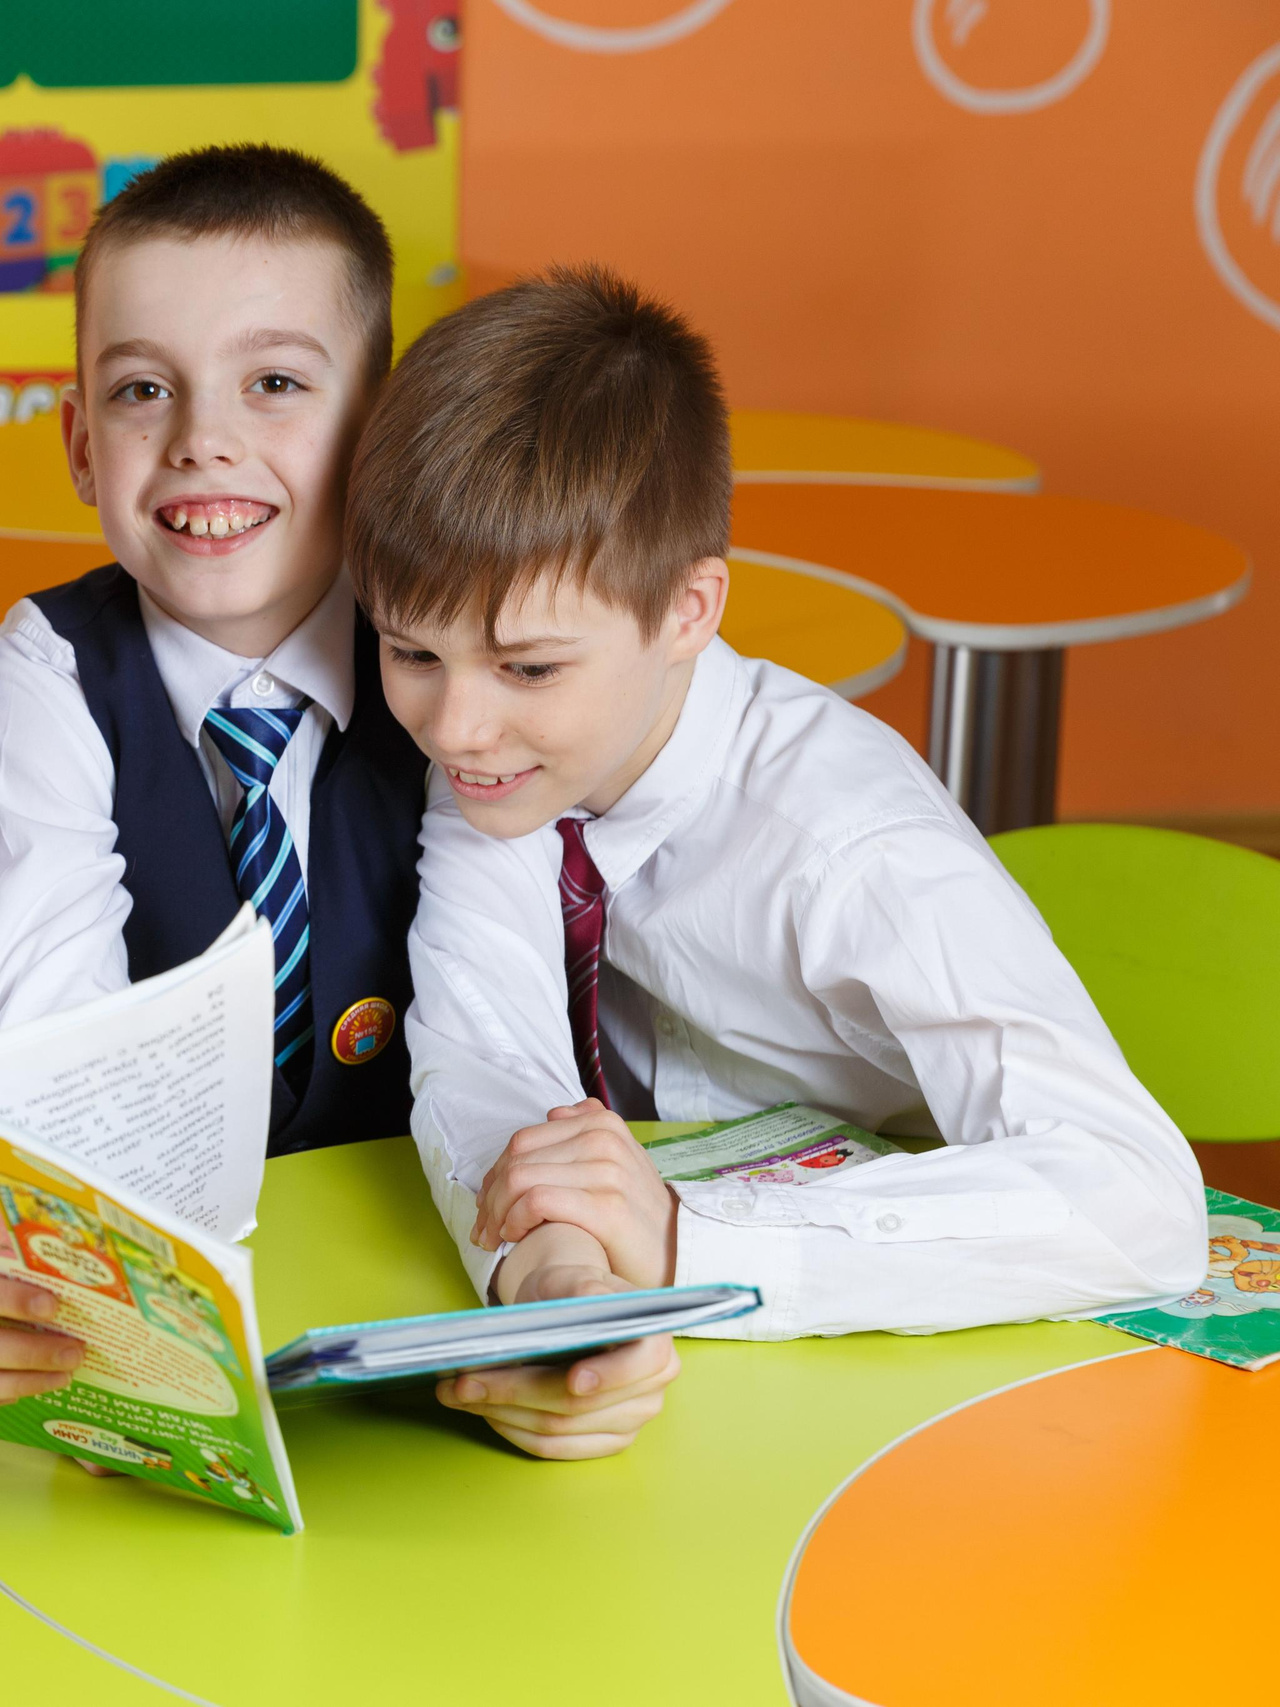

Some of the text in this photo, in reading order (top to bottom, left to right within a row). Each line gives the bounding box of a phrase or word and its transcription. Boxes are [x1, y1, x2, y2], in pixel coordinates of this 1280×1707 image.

[4, 190, 36, 246] 2
[60, 188, 89, 238] 3
[341, 1003, 369, 1031] СРЕДНЯЯ
[34, 1394, 62, 1408] БЕЗ
[77, 1387, 108, 1404] БЕЗ
[67, 1404, 113, 1423] САМИ
[113, 1398, 154, 1417] САМ
[157, 1410, 213, 1434] ЧИТАЙ
[157, 1420, 185, 1433] ДЛЯ
[52, 1428, 140, 1461] ЧИТАЕМ САМИ
